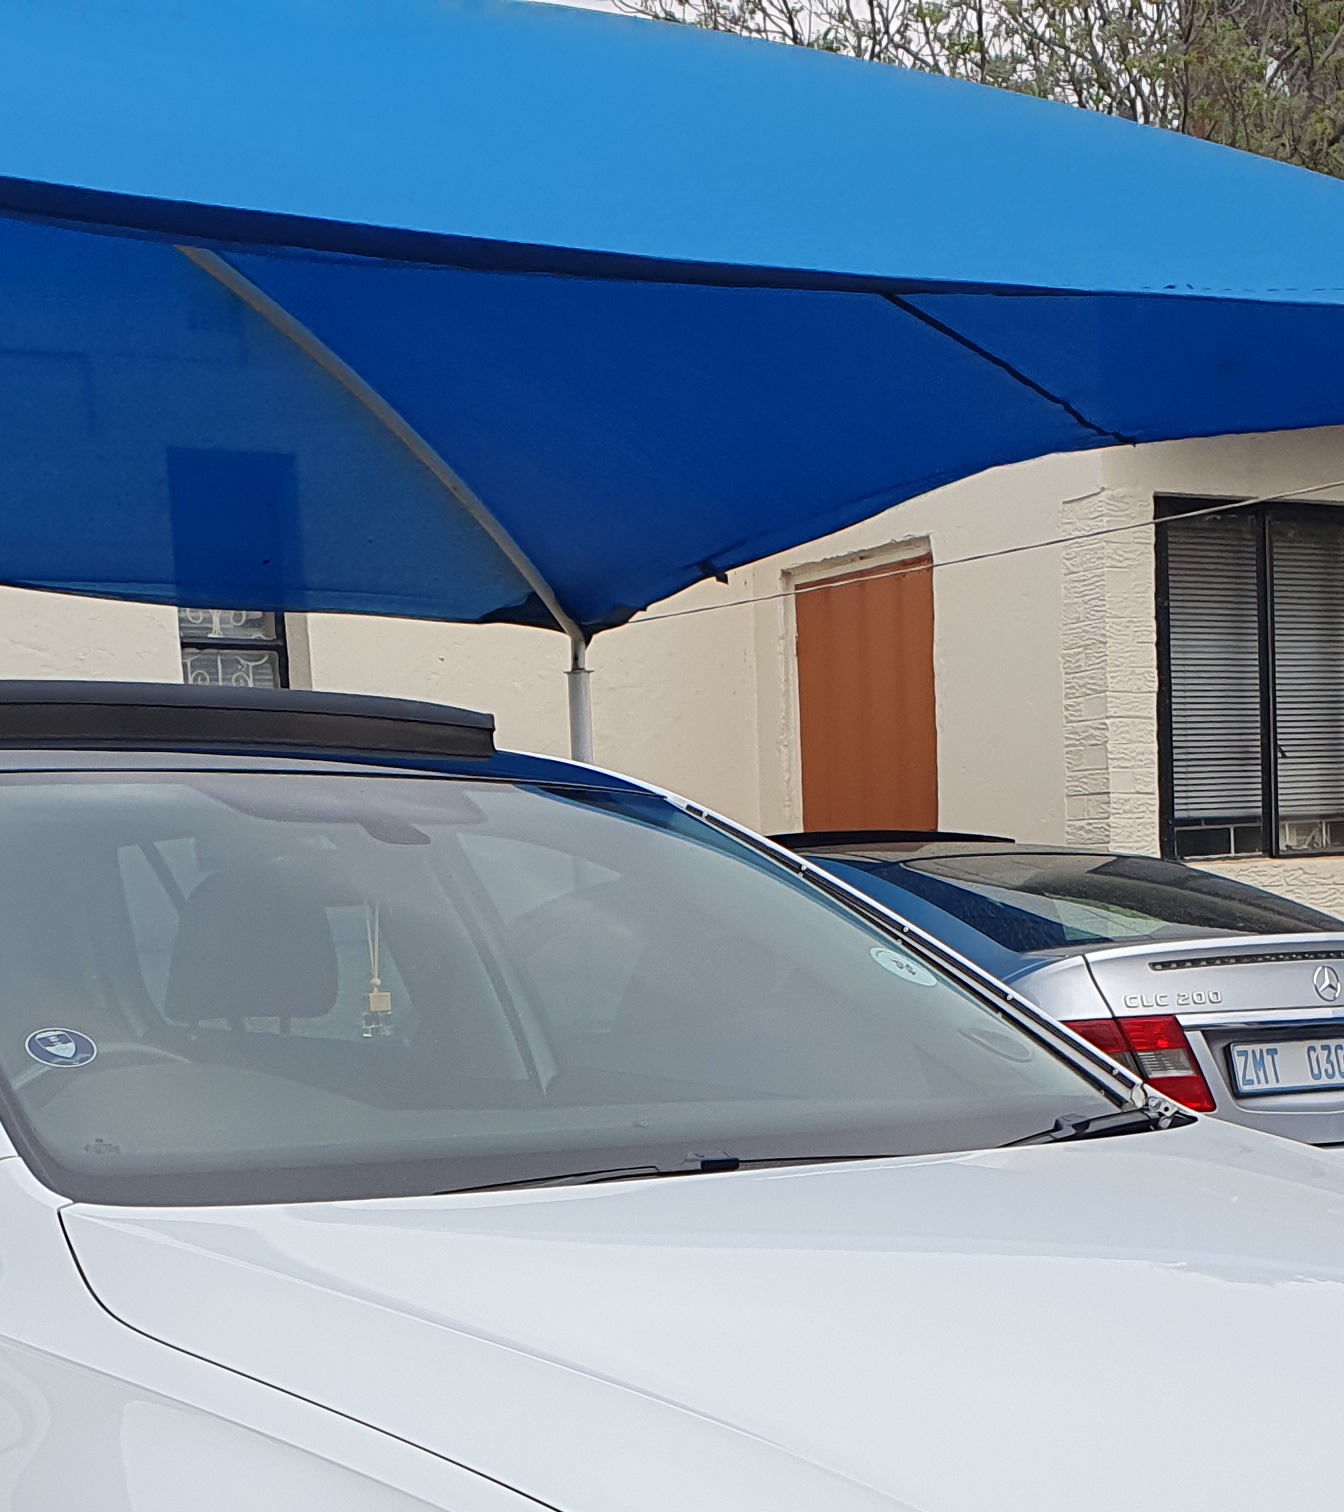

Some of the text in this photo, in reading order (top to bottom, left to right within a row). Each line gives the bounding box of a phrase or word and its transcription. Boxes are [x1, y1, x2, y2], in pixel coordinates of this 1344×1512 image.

[1124, 991, 1222, 1008] CLC 200
[1237, 1047, 1281, 1086] ZMT
